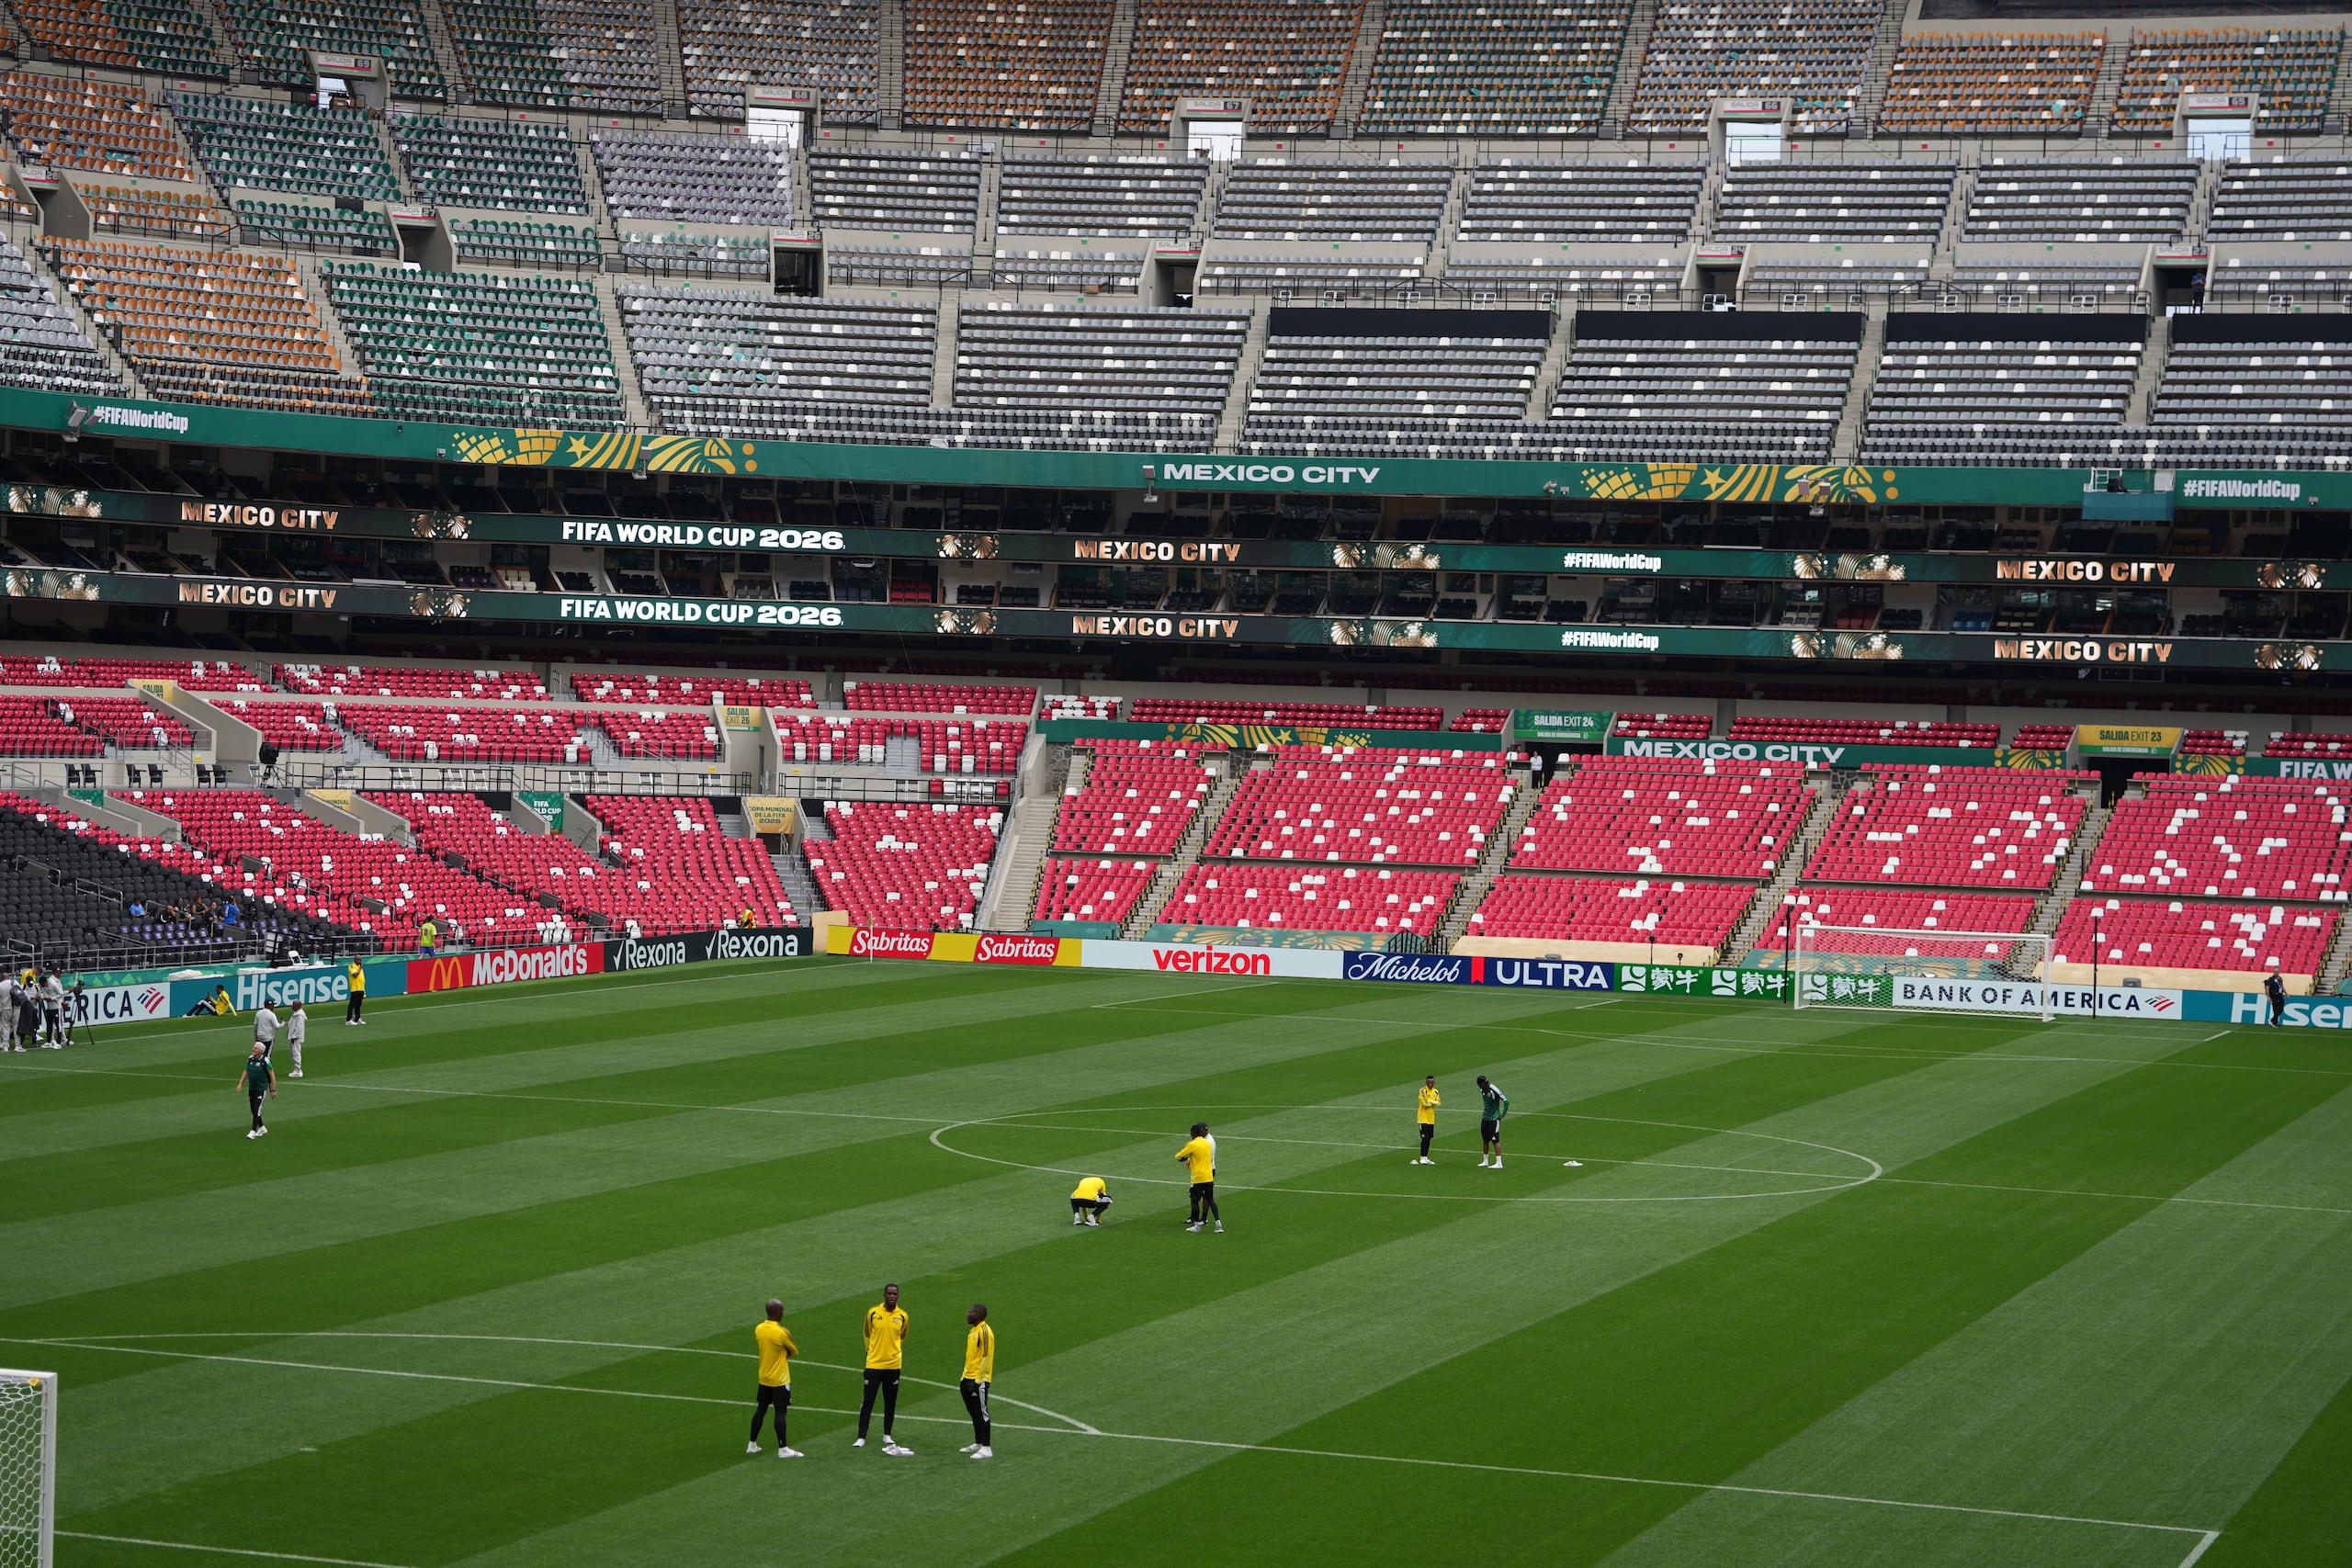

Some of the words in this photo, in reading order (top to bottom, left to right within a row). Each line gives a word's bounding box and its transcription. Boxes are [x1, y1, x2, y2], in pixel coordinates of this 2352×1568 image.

[356, 60, 370, 68] 69
[94, 406, 188, 434] #FIFAWorldCup
[1164, 463, 1295, 483] MEXICO
[1302, 467, 1380, 484] CITY
[2183, 479, 2301, 501] #FIFAWorldCup
[181, 502, 275, 527] MEXICO
[281, 509, 338, 529] CITY
[562, 521, 613, 542] FIFA
[616, 523, 703, 546] WORLD
[707, 527, 755, 547] CUP
[759, 530, 843, 549] 2026
[1074, 540, 1174, 561] MEXICO
[1182, 543, 1240, 562] CITY
[1564, 553, 1661, 572] #FIFAWorldCup
[1997, 560, 2103, 581] MEXICO
[2110, 562, 2175, 582] CITY
[179, 582, 272, 606] MEXICO
[279, 588, 336, 608] CITY
[560, 599, 611, 619] FIFA
[615, 601, 701, 622] WORLD
[706, 605, 753, 623] CUP
[757, 606, 842, 626] 2026
[1073, 615, 1172, 637] MEXICO
[1178, 619, 1238, 637] CITY
[1562, 631, 1659, 652] #FIFAWorldCup
[1994, 639, 2100, 660] MEXICO
[2108, 643, 2172, 661] CITY
[727, 707, 750, 716] SALIDA
[1534, 715, 1562, 726] SALIDA
[1564, 716, 1582, 727] EXIT
[1582, 716, 1594, 728] 24
[2099, 730, 2130, 740] SALIDA
[2132, 731, 2150, 741] EXIT
[2151, 731, 2161, 742] 23
[1624, 740, 1757, 761] MEXICO
[1764, 744, 1845, 763] CITY
[2280, 761, 2330, 779] FIFA
[717, 930, 797, 959] Rexona
[853, 930, 930, 953] Sabritas
[978, 937, 1055, 961] Sabritas
[472, 944, 588, 987] McDonald's
[625, 939, 685, 970] Rexona
[1153, 944, 1271, 975] verizon
[1348, 952, 1462, 983] Michelob
[1496, 961, 1609, 988] ULTRA
[1650, 968, 1699, 994] 蒙牛
[237, 975, 348, 1010] Hisense
[1742, 972, 1790, 998] 蒙牛
[1832, 976, 1881, 1001] 蒙牛
[1903, 983, 1972, 1003] BANK
[1981, 987, 2013, 1005] OF
